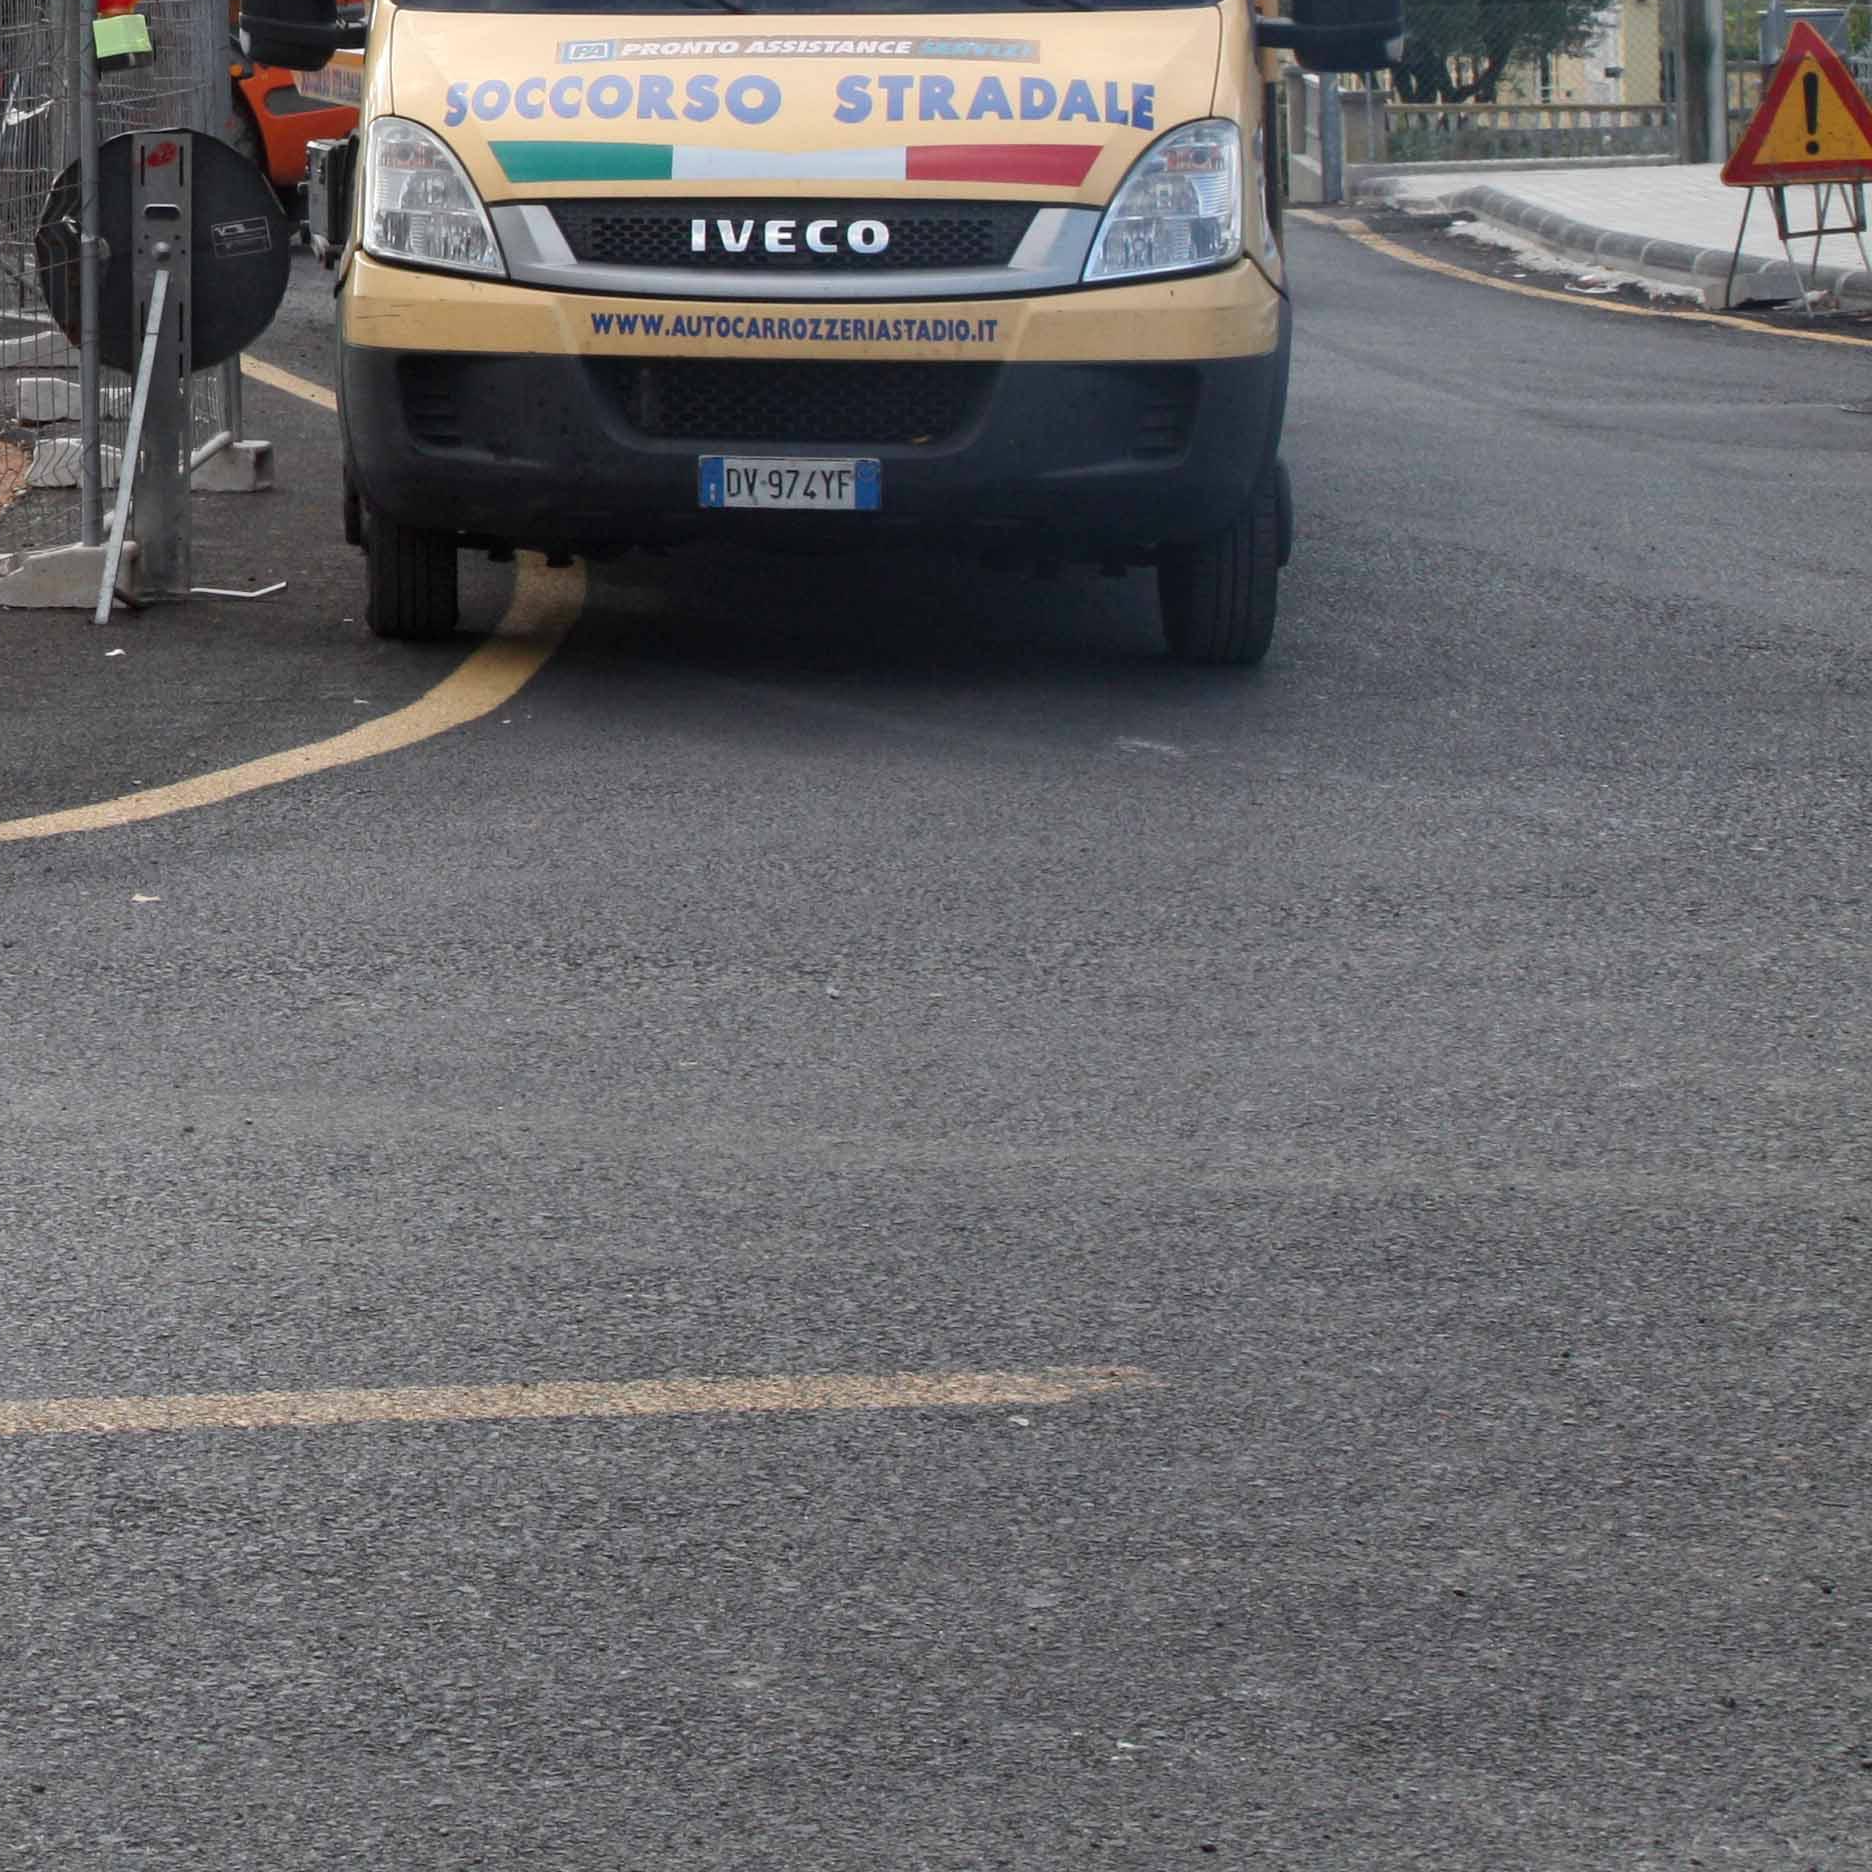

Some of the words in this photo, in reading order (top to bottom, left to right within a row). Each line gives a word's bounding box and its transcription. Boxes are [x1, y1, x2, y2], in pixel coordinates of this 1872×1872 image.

[622, 40, 738, 57] PRONTO
[744, 40, 913, 55] ASSISTANCE
[443, 74, 782, 127] SOCCORSO
[833, 74, 1155, 131] STRADALE
[691, 219, 890, 254] IVECO
[591, 312, 998, 342] WWW.AUTOCARROZZERIASTADIO.IT
